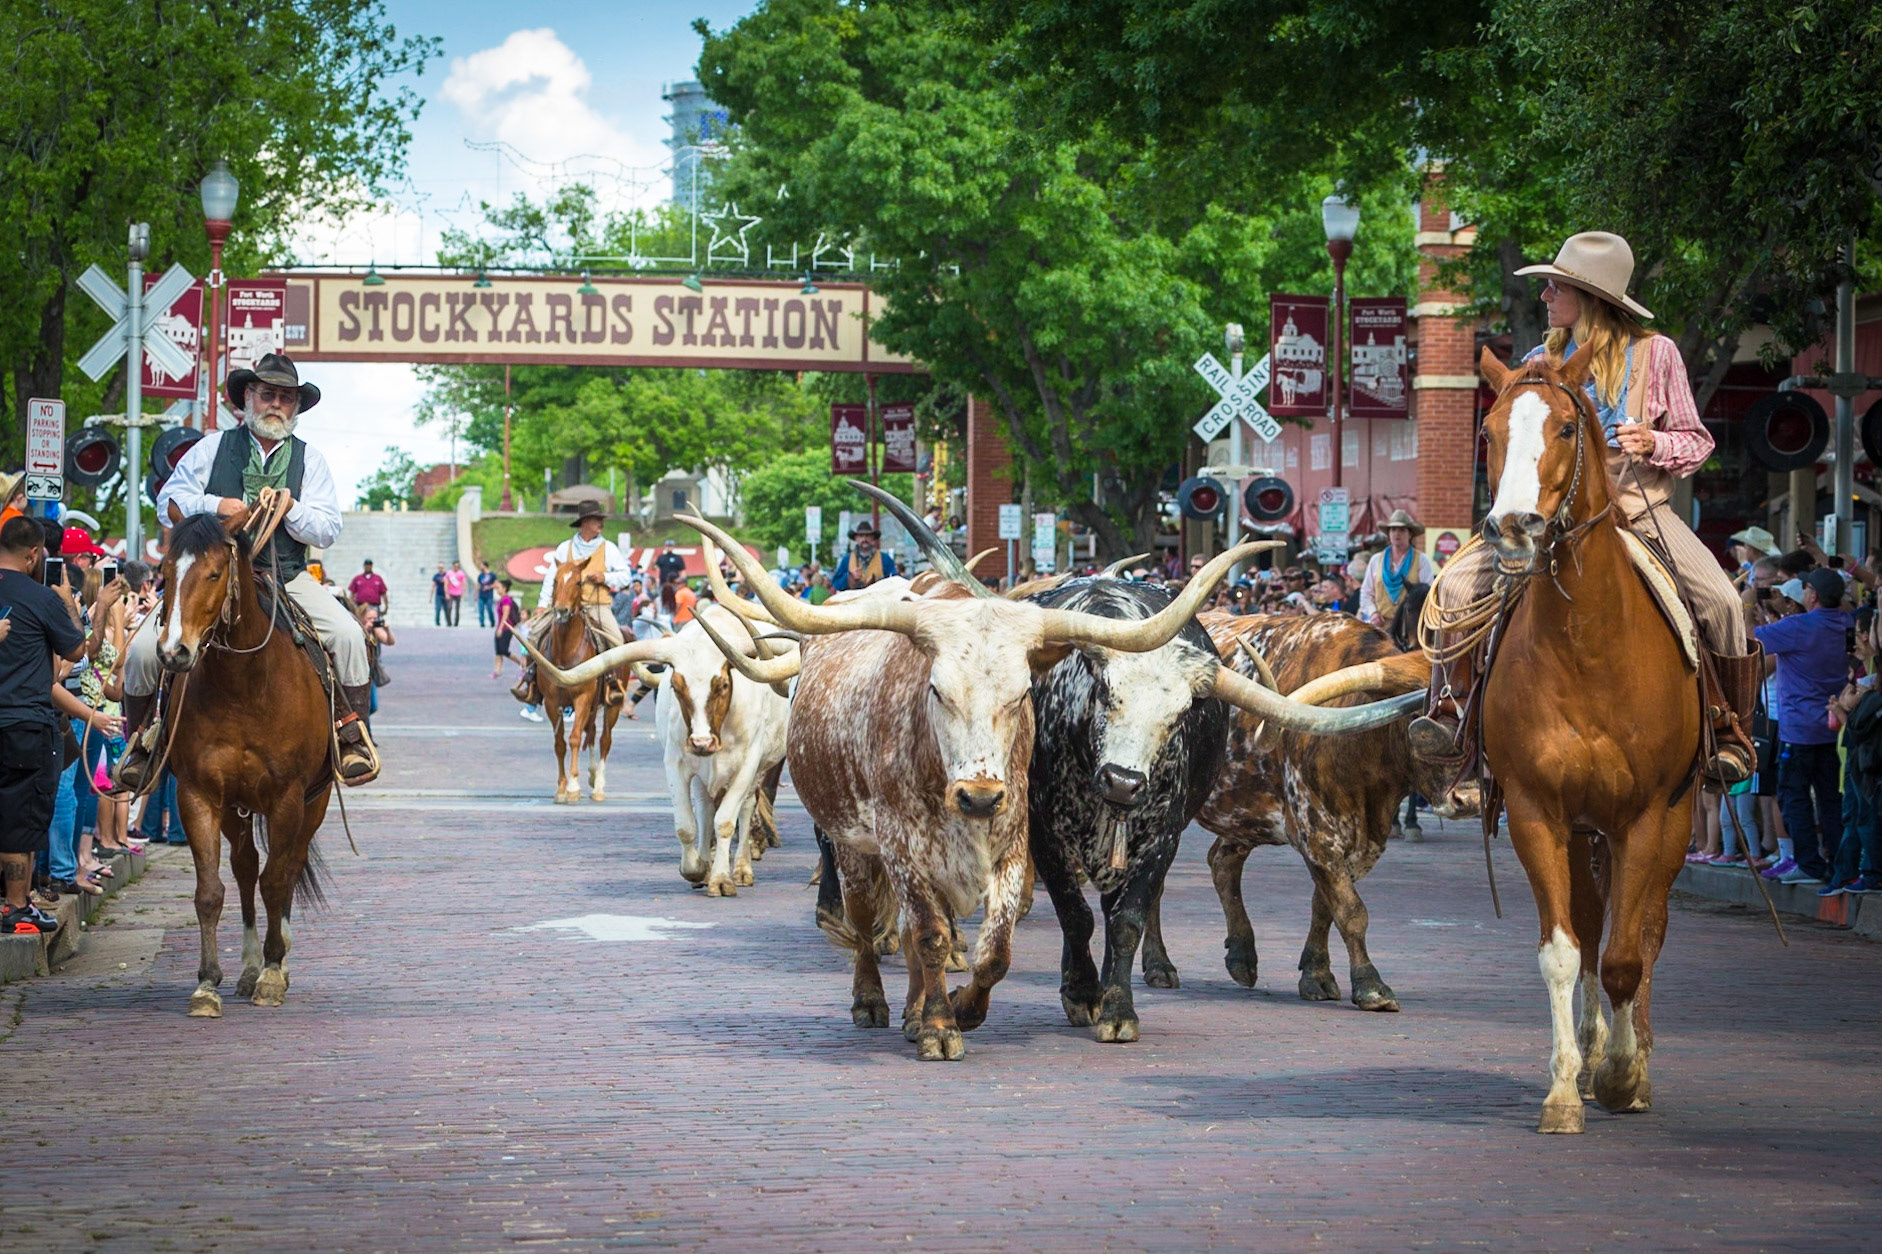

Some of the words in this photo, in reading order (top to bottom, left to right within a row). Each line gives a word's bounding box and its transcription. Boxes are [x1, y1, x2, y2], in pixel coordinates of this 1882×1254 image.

[232, 298, 281, 307] STOCKYARDS
[338, 290, 633, 345] STOCKYARDS
[652, 295, 842, 351] STATION
[1199, 358, 1229, 393] RAIL
[1242, 403, 1277, 438] ROAD
[40, 405, 53, 417] NO
[33, 418, 60, 428] PARKING
[32, 428, 60, 439] STOPPING
[41, 440, 50, 448] OR
[31, 449, 60, 459] STANDING
